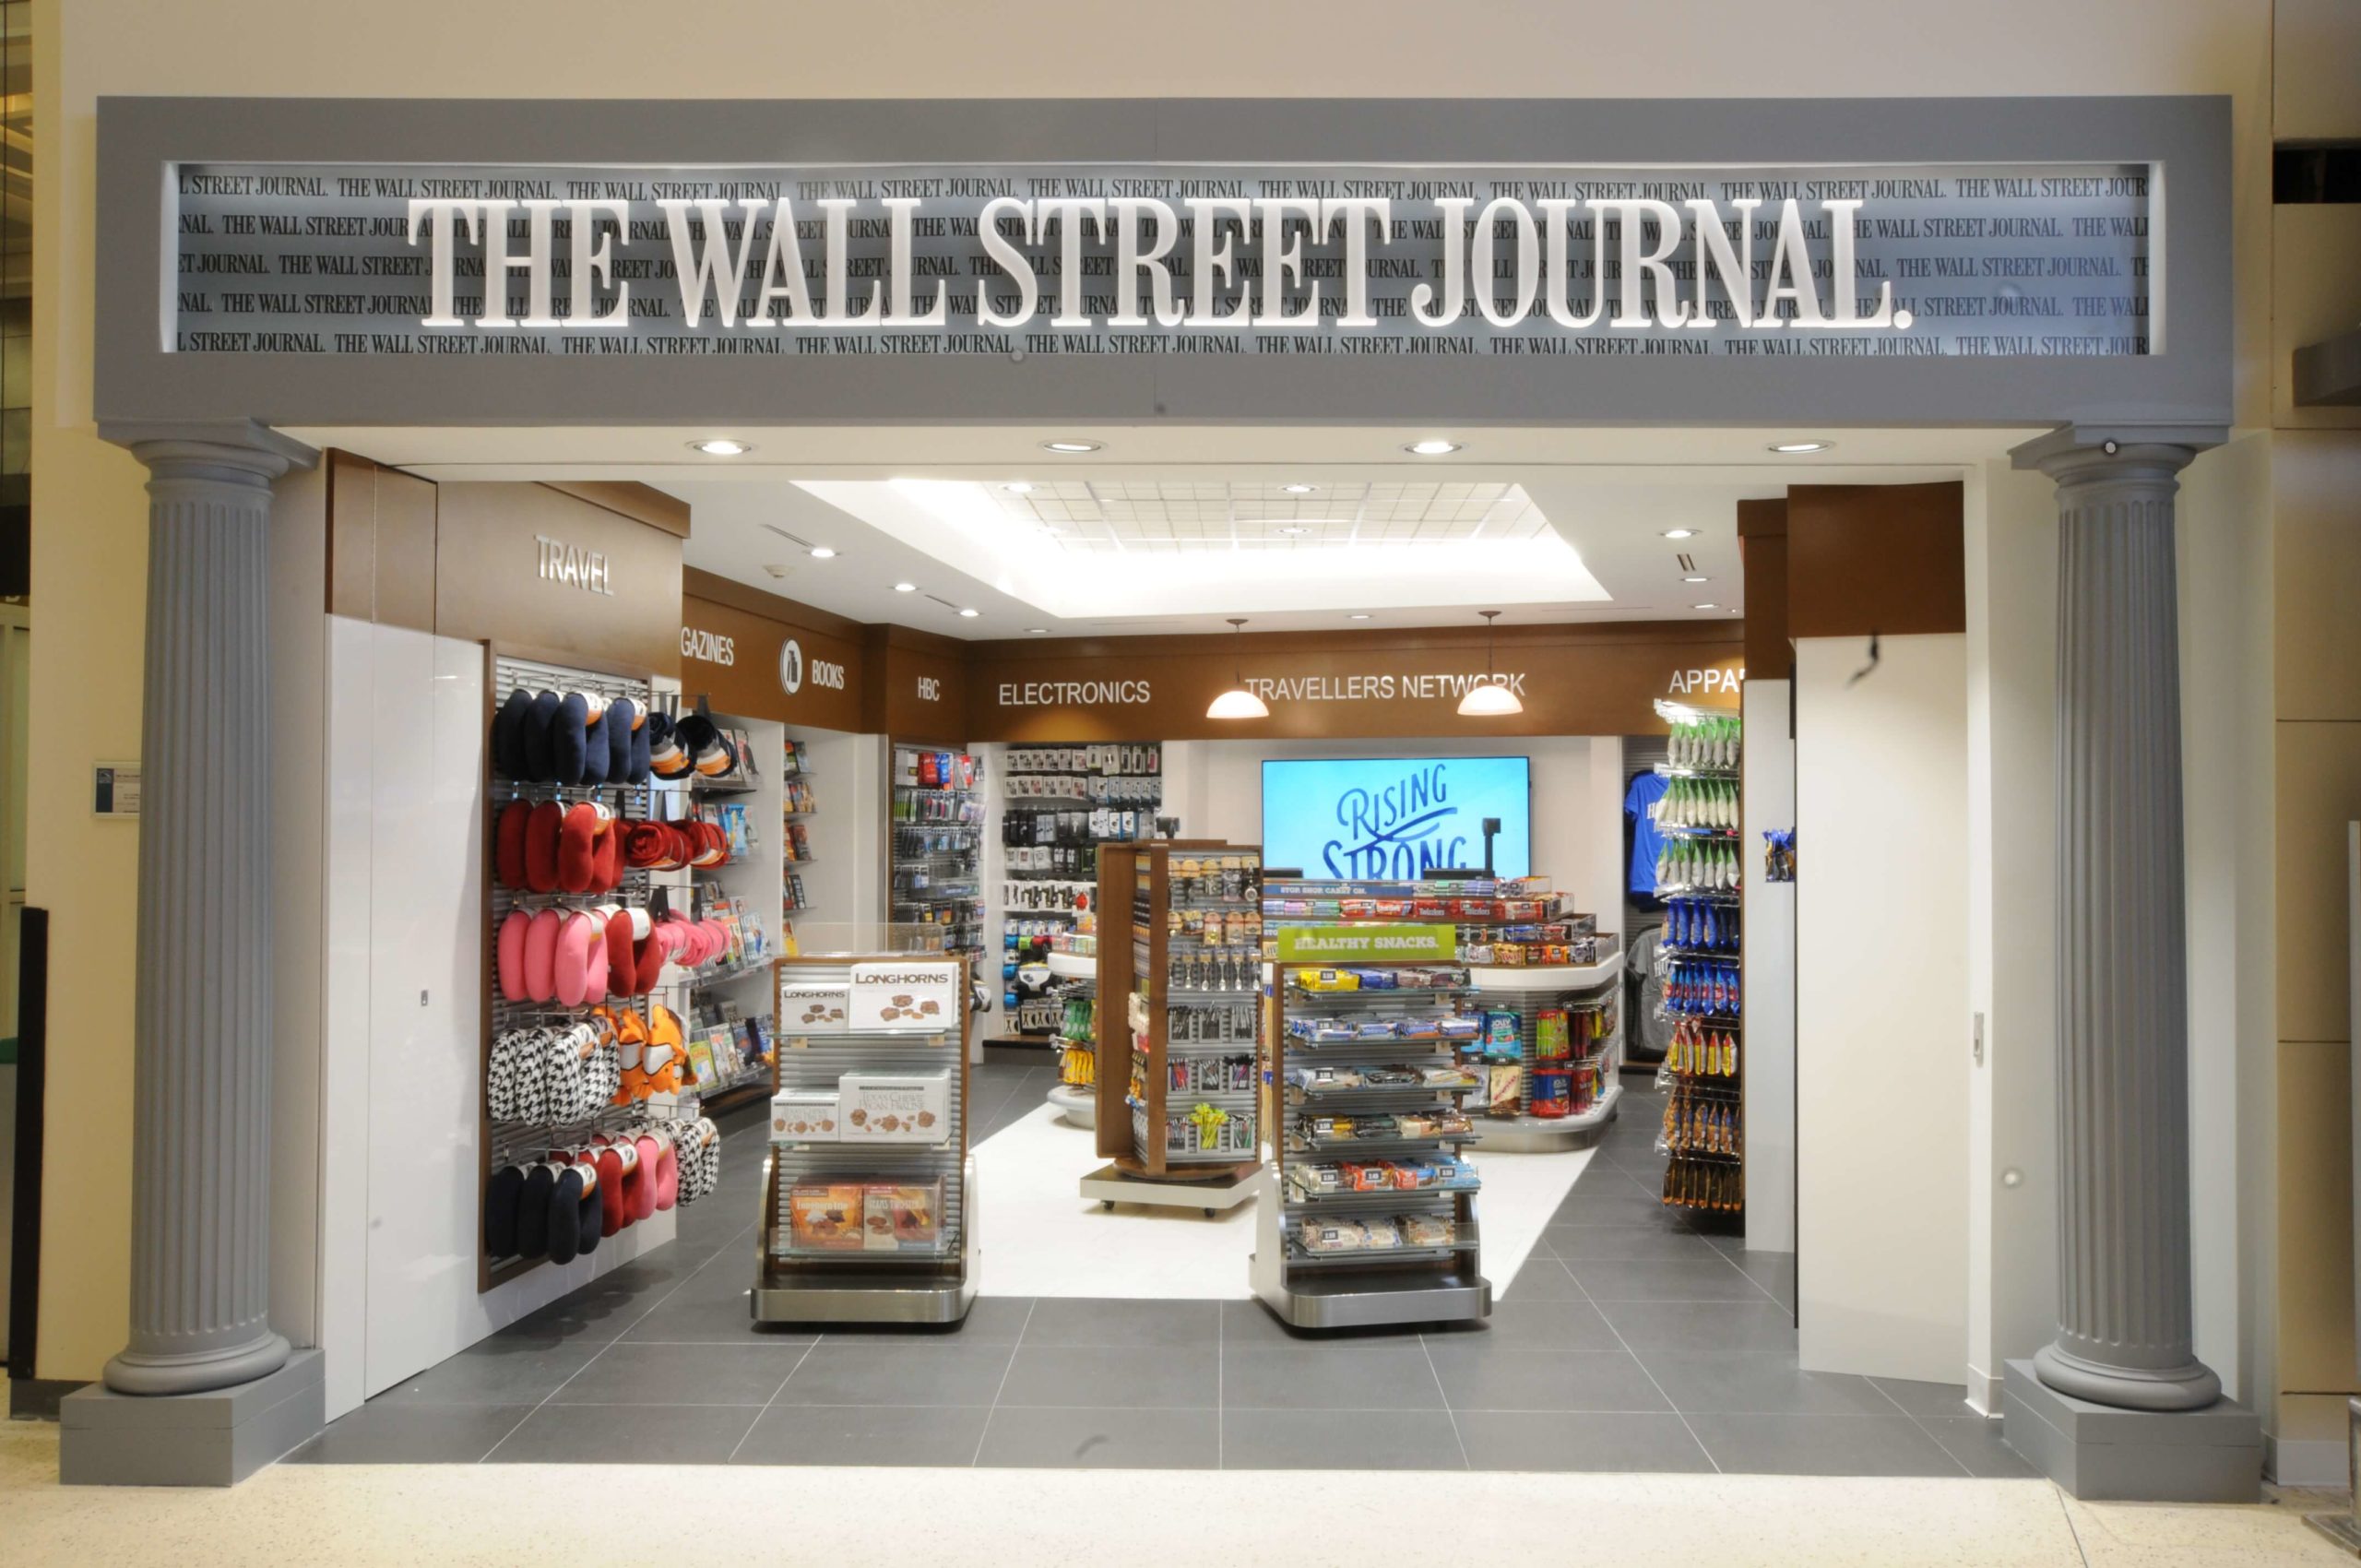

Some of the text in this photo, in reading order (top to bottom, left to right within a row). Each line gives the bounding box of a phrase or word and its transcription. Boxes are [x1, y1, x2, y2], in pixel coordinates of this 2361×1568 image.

[192, 175, 254, 196] STREET
[255, 176, 328, 196] JOURNAL.
[338, 178, 370, 197] THE
[375, 178, 417, 198] WALL
[421, 179, 482, 199] STREET
[485, 180, 557, 199] JOURNAL.
[567, 181, 600, 200] THE
[605, 182, 647, 201] WALL
[651, 182, 712, 200] STREET
[797, 181, 830, 200] THE
[835, 180, 877, 200] WALL
[882, 178, 943, 198] STREET
[946, 178, 1018, 197] JOURNAL.
[1027, 178, 1061, 197] THE
[1065, 178, 1108, 198] WALL
[1111, 179, 1173, 199] STREET
[1176, 180, 1249, 199] JOURNAL.
[1259, 180, 1292, 199] THE
[1297, 180, 1339, 199] WALL
[1343, 181, 1405, 200] STREET
[1407, 182, 1480, 200] JOURNAL.
[1490, 182, 1524, 200] THE
[1528, 182, 1571, 200] WALL
[1575, 182, 1636, 200] STREET
[1721, 182, 1754, 200] THE
[1759, 181, 1802, 200] WALL
[1806, 180, 1869, 199] STREET
[1871, 179, 1946, 198] JOURNAL.
[1956, 178, 1989, 197] THE
[1995, 178, 2037, 197] WALL
[2041, 178, 2102, 197] STREET
[2106, 177, 2148, 197] JOUR
[222, 215, 255, 235] THE
[261, 216, 301, 235] WALL
[305, 217, 367, 236] STREET
[912, 218, 945, 237] THE
[950, 218, 979, 237] WAL
[1413, 220, 1444, 240] WAL
[1877, 219, 1920, 238] WALL
[1924, 218, 1987, 238] STREET
[1988, 218, 2063, 238] JOURNAL.
[2072, 218, 2106, 237] THE
[197, 254, 270, 274] JOURNAL.
[279, 255, 312, 275] THE
[316, 255, 359, 275] WALL
[362, 255, 422, 276] STREET
[969, 256, 1002, 276] THE
[1236, 257, 1264, 277] WAL
[1897, 258, 1930, 278] THE
[1935, 257, 1978, 277] WALL
[1982, 256, 2045, 277] STREET
[2047, 256, 2121, 277] JOURNAL.
[408, 196, 1912, 329] THE WALL STREET JOURNAL.
[221, 293, 254, 314] THE
[258, 294, 301, 314] WALL
[304, 294, 365, 314] STREET
[950, 296, 979, 315] WAL
[1372, 298, 1406, 316] THE
[1925, 297, 1987, 317] STREET
[1989, 296, 2063, 317] JOURNAL.
[2073, 296, 2106, 317] THE
[191, 332, 250, 352] STREET
[253, 333, 325, 352] JOURNAL.
[335, 333, 367, 353] THE
[372, 334, 413, 353] WALL
[418, 335, 478, 354] STREET
[563, 337, 595, 354] THE
[599, 337, 642, 354] WALL
[647, 337, 709, 354] STREET
[797, 337, 829, 354] THE
[834, 336, 876, 354] WALL
[881, 335, 941, 354] STREET
[1026, 334, 1058, 353] THE
[1062, 335, 1105, 354] WALL
[1109, 335, 1169, 354] STREET
[1255, 336, 1289, 354] THE
[1294, 336, 1336, 354] WALL
[1341, 337, 1404, 354] STREET
[1490, 338, 1524, 354] THE
[1528, 338, 1571, 354] WALL
[1575, 338, 1638, 354] STREET
[1725, 339, 1759, 355] THE
[1762, 339, 1806, 355] WALL
[1809, 338, 1870, 355] STREET
[1956, 337, 1989, 355] THE
[1995, 337, 2037, 355] WALL
[2041, 337, 2103, 355] STREET
[2106, 336, 2148, 355] JOUR
[533, 534, 614, 596] TRAVEL
[812, 659, 844, 690] BOOKS
[1668, 668, 1745, 694] APPA
[918, 676, 940, 701] HBC
[999, 681, 1151, 706] ELECTRONICS
[1245, 675, 1394, 700] TRAVELLERS
[1336, 763, 1446, 840] RISING
[1294, 936, 1440, 951] HEALTHY SNACKS.
[855, 973, 949, 984] LONGHORNS
[784, 990, 846, 999] LONGHORNS
